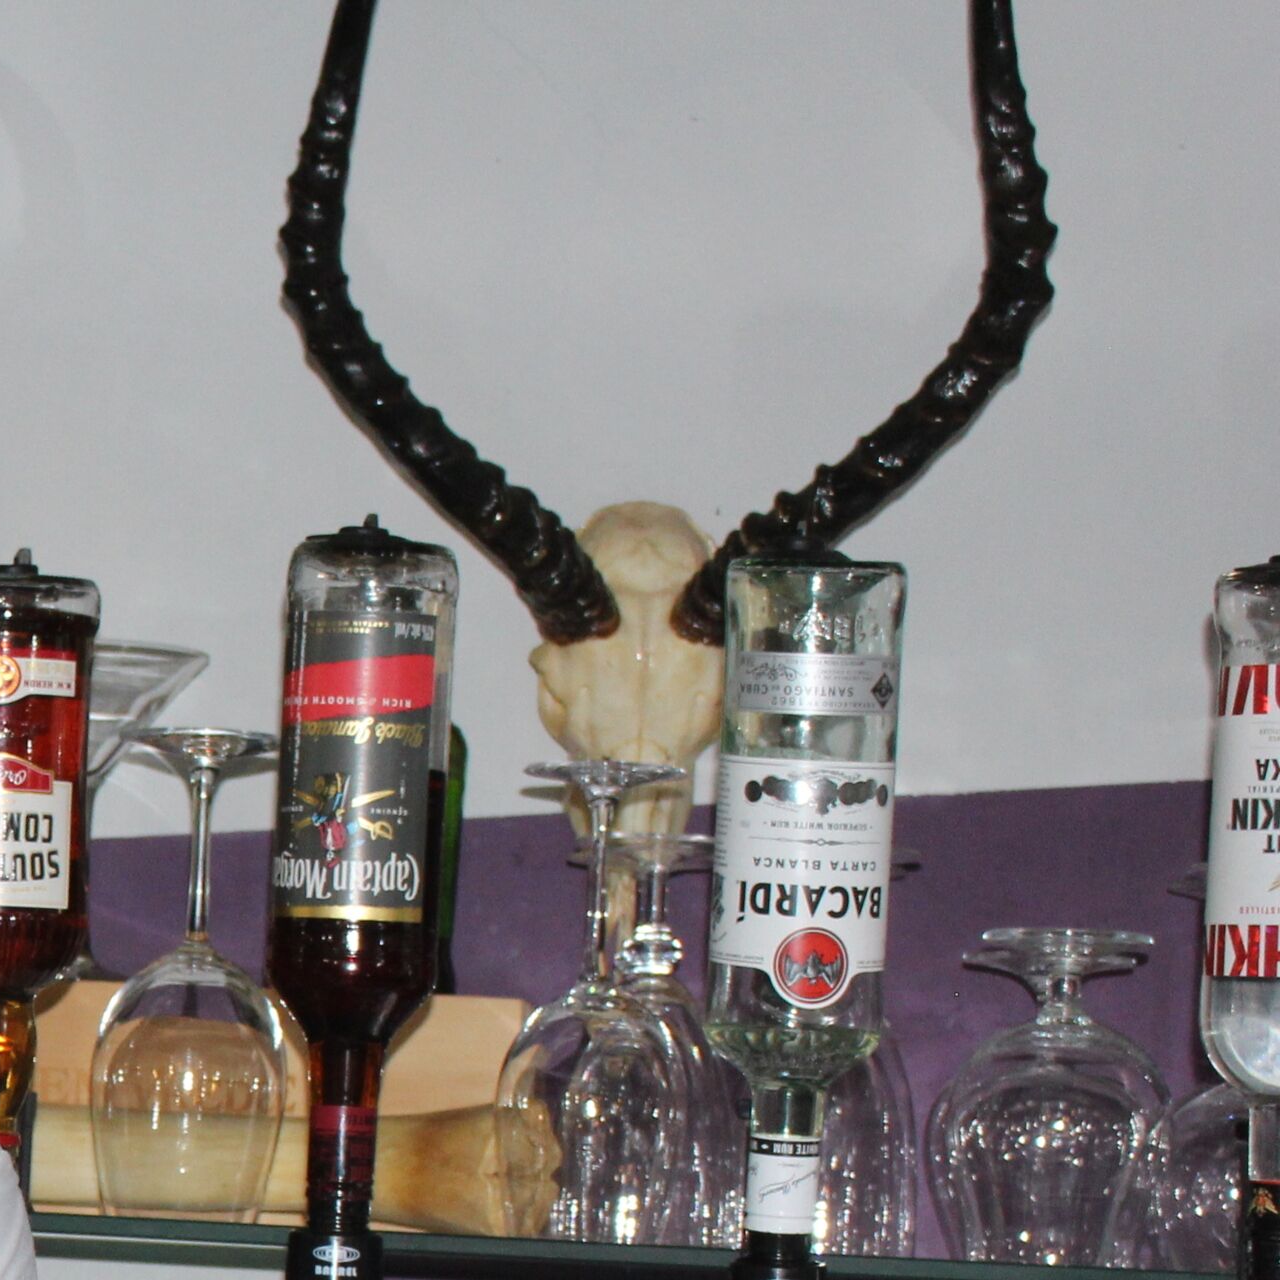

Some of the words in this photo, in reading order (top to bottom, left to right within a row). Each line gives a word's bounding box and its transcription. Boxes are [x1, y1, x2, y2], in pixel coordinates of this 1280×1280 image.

[382, 697, 413, 709] RICH
[375, 722, 425, 748] Black
[751, 856, 822, 871] BLANCA
[829, 860, 877, 873] CARTA
[272, 850, 332, 900] Morga
[334, 852, 420, 902] Captain
[772, 1142, 795, 1154] RUM
